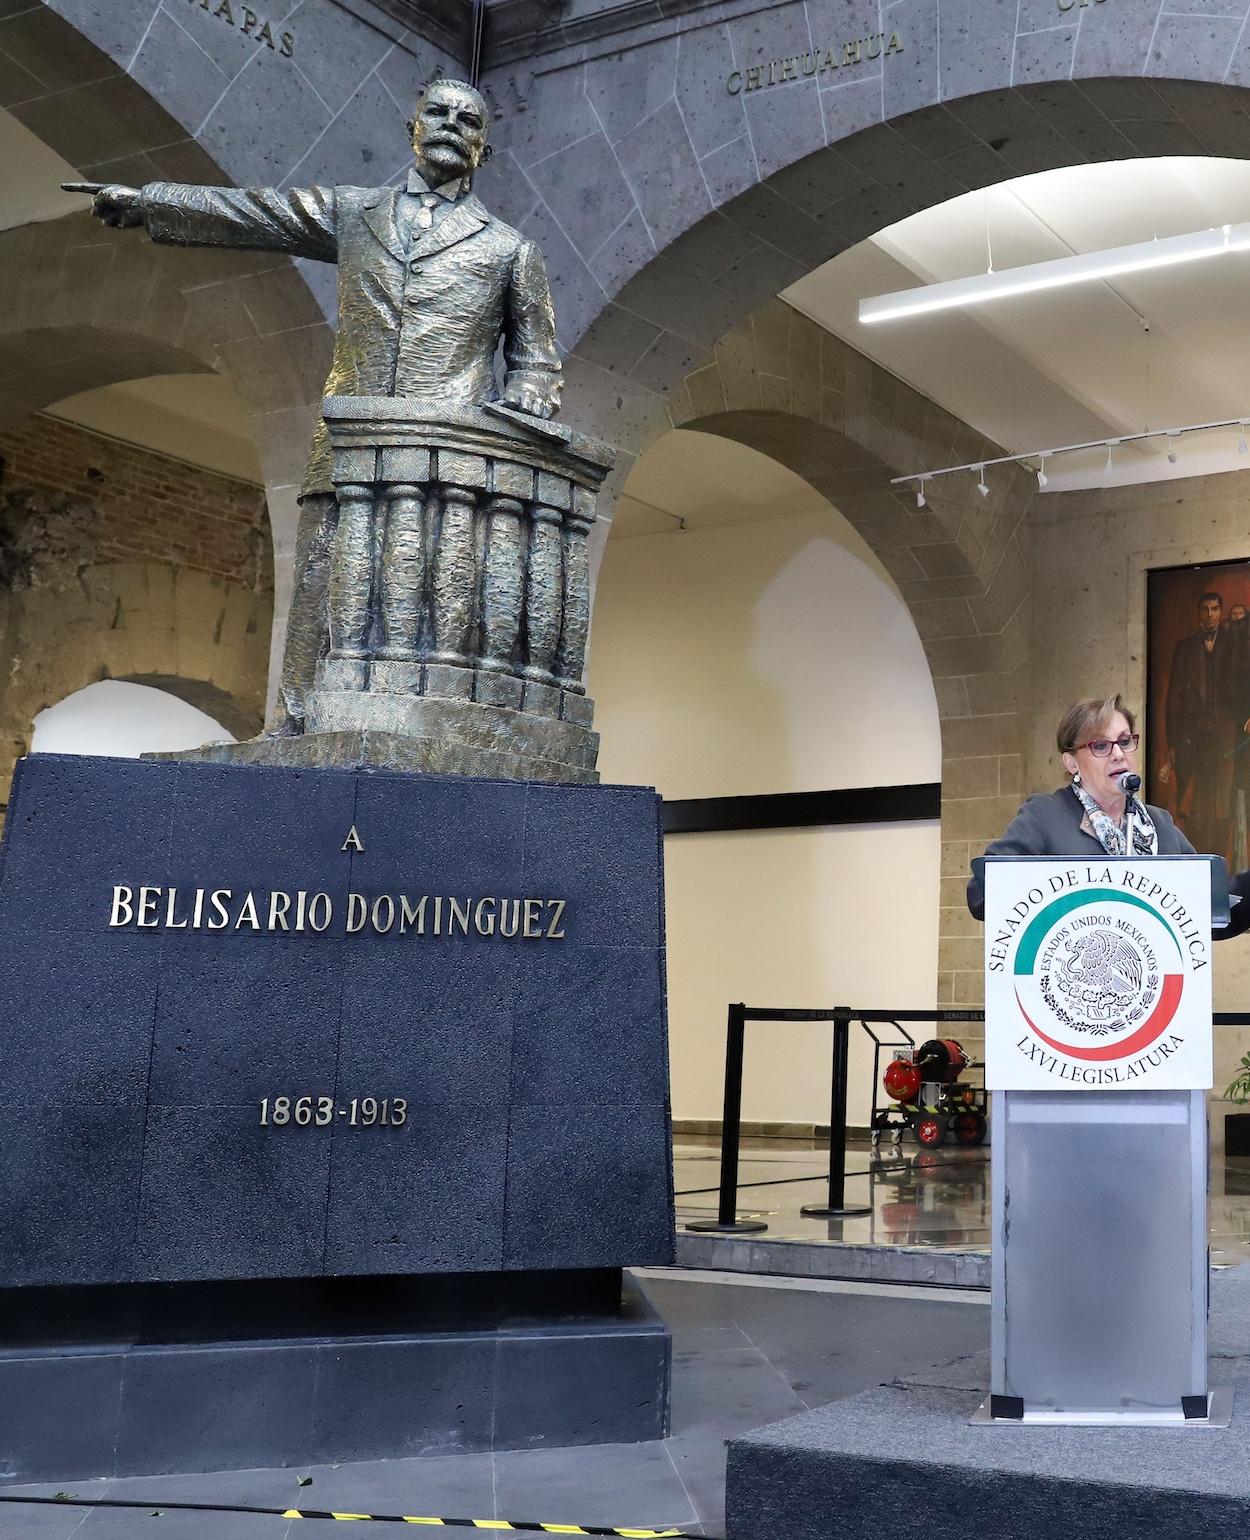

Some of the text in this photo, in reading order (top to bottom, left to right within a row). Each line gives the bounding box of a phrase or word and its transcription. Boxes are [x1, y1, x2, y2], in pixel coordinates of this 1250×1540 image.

[187, 0, 295, 58] APAS
[727, 32, 904, 95] CHIHUAHUA
[341, 825, 364, 852] A
[109, 886, 566, 938] BELISARIO DOMINGUEZ
[989, 867, 1207, 972] SENADO DE LA REPÚBLICA
[1040, 915, 1158, 972] ESTADOS UNIDOS MEXICANOS
[1016, 1033, 1185, 1084] LXVI LEGISLATURA
[259, 1097, 408, 1126] 1863-1913
